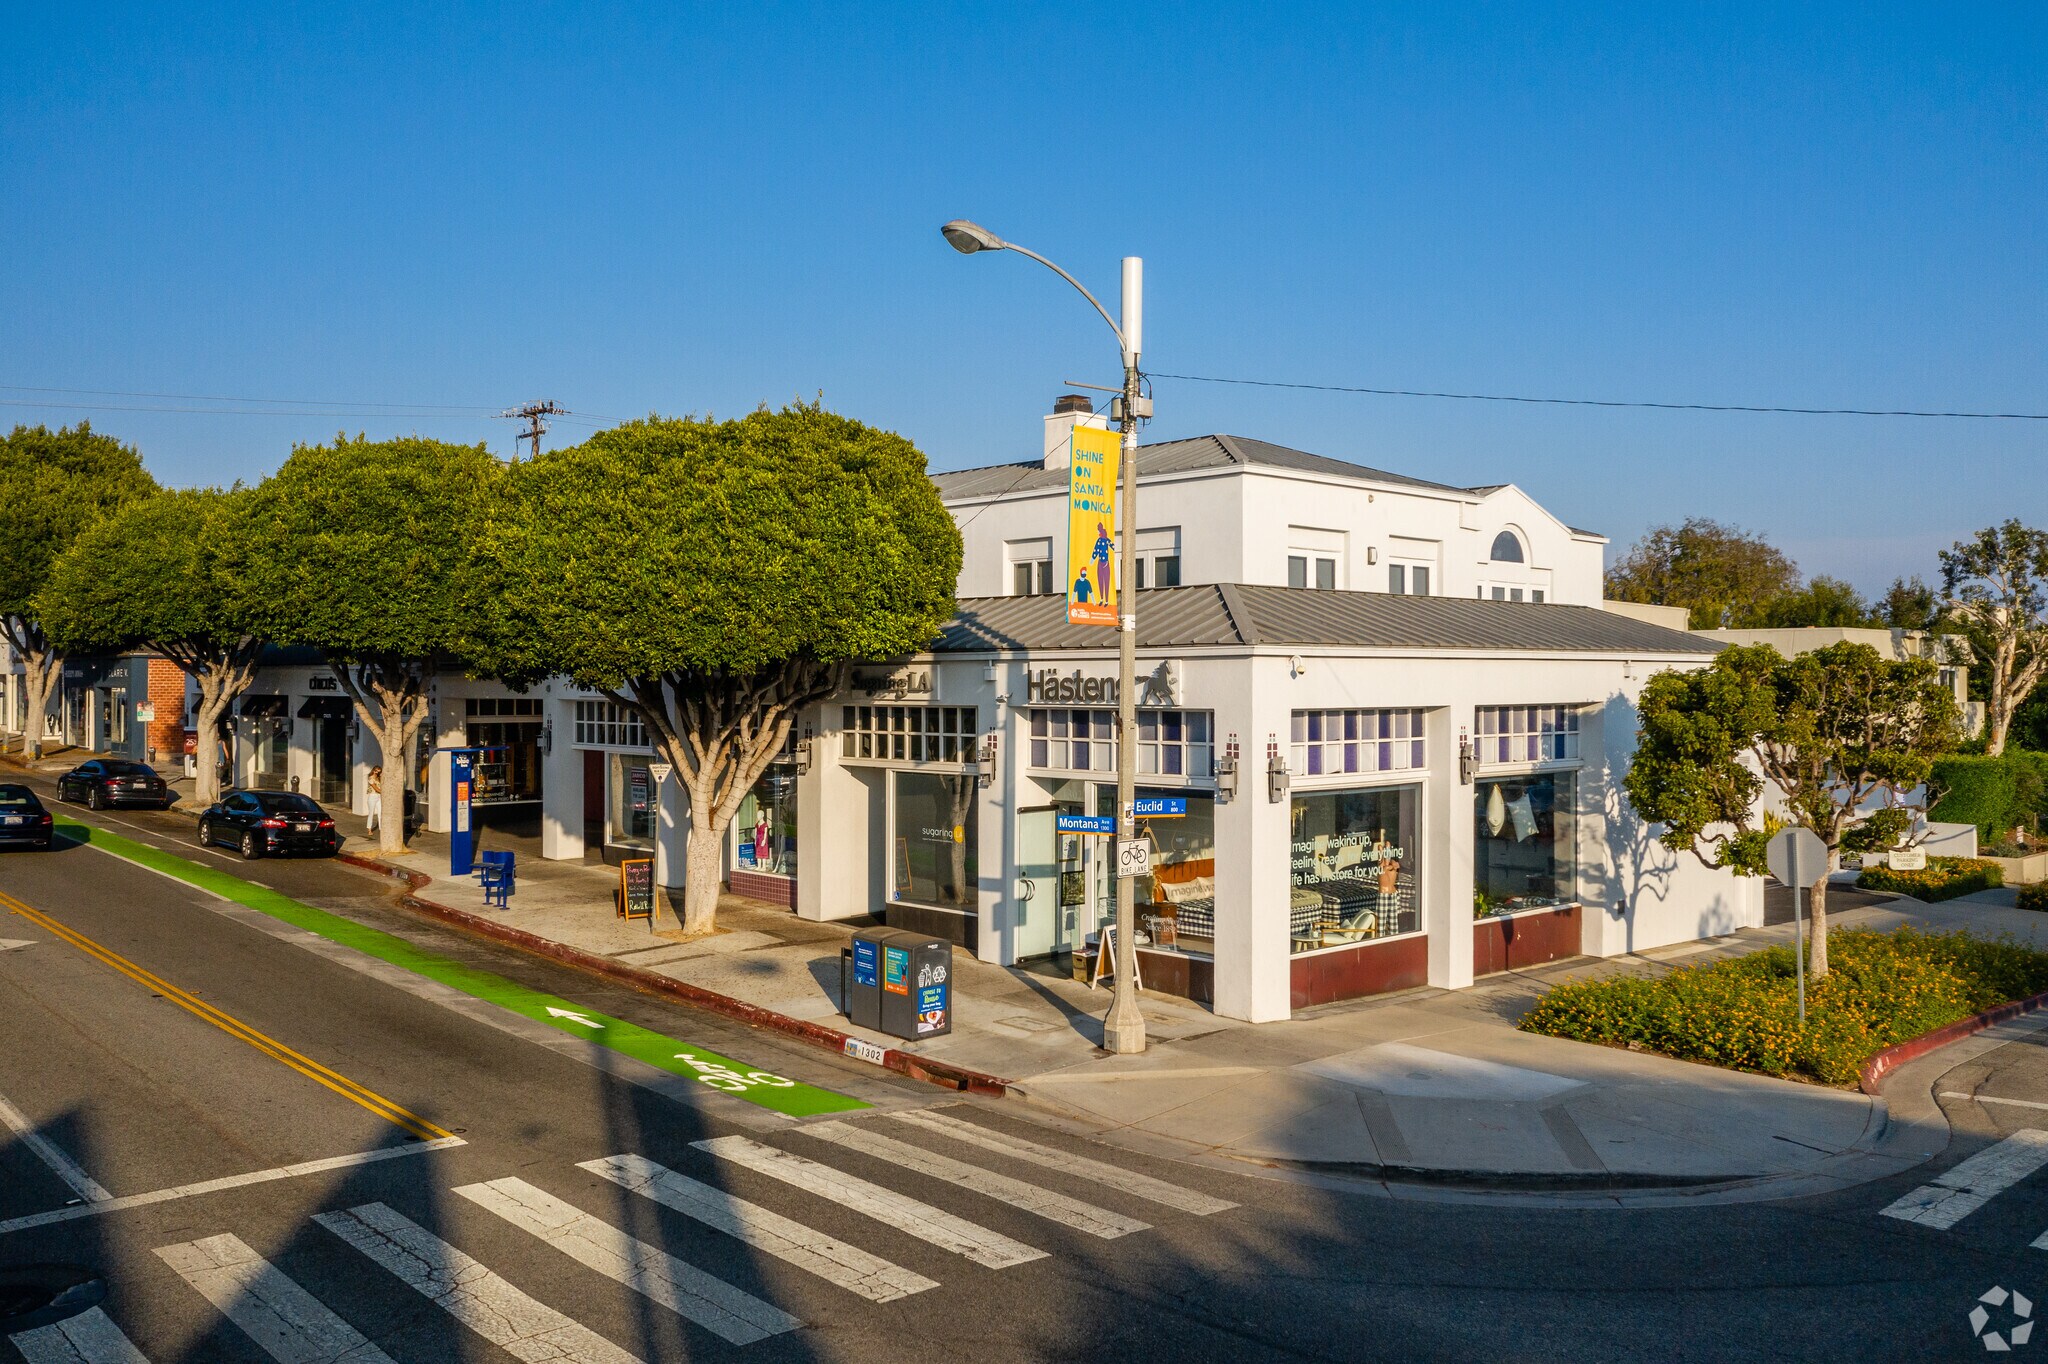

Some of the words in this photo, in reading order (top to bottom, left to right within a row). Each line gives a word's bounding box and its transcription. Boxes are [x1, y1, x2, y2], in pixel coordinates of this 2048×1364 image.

[1076, 448, 1104, 465] SHINE
[1075, 465, 1091, 479] ON
[1074, 482, 1104, 497] SANTA
[1073, 499, 1112, 515] MONICA
[1136, 801, 1163, 812] Euclid
[1059, 818, 1099, 830] Montana
[922, 827, 953, 839] sugaring
[1327, 835, 1357, 849] waking
[1359, 835, 1372, 846] up,
[1361, 846, 1404, 862] everything
[1121, 867, 1132, 875] BIKE
[1133, 864, 1147, 874] LANE
[1291, 873, 1303, 886] ife
[1304, 873, 1320, 885] has
[1331, 868, 1353, 881] store
[1354, 865, 1368, 877] for
[861, 1046, 880, 1061] 1302
